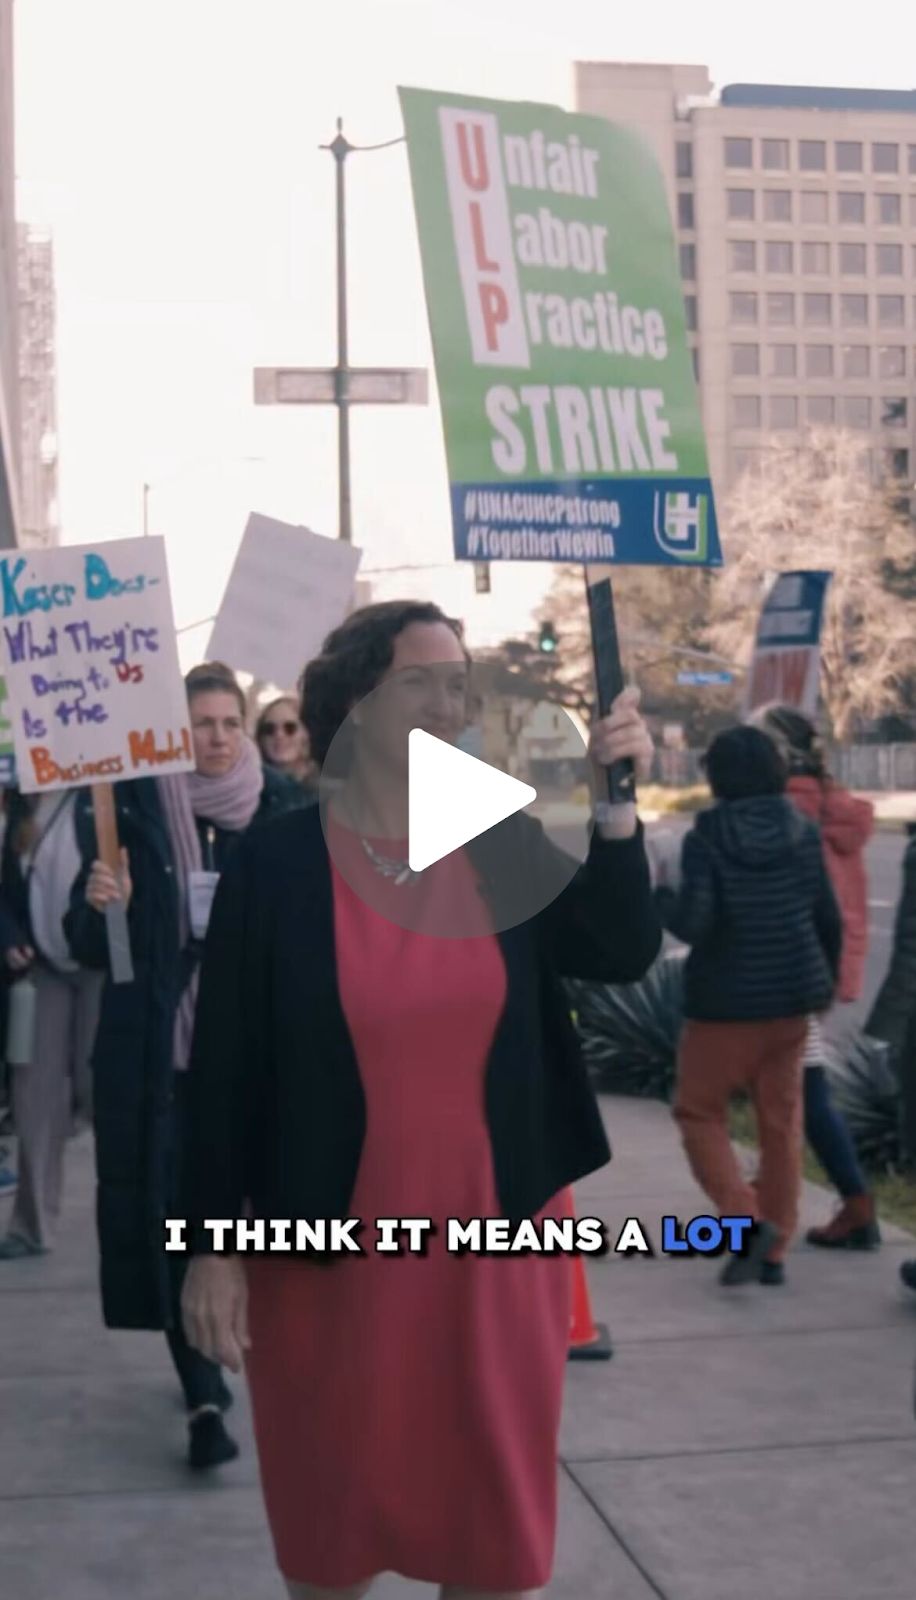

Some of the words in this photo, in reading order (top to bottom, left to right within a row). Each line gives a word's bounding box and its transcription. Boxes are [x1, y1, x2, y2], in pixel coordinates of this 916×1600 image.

[455, 120, 599, 199] Unfair
[468, 200, 608, 275] Labor
[477, 281, 668, 361] Practice
[484, 384, 679, 475] STRIKE
[466, 526, 615, 557] #TogetherWeWin
[3, 620, 57, 664] What
[55, 698, 108, 726] the
[29, 746, 124, 785] Business
